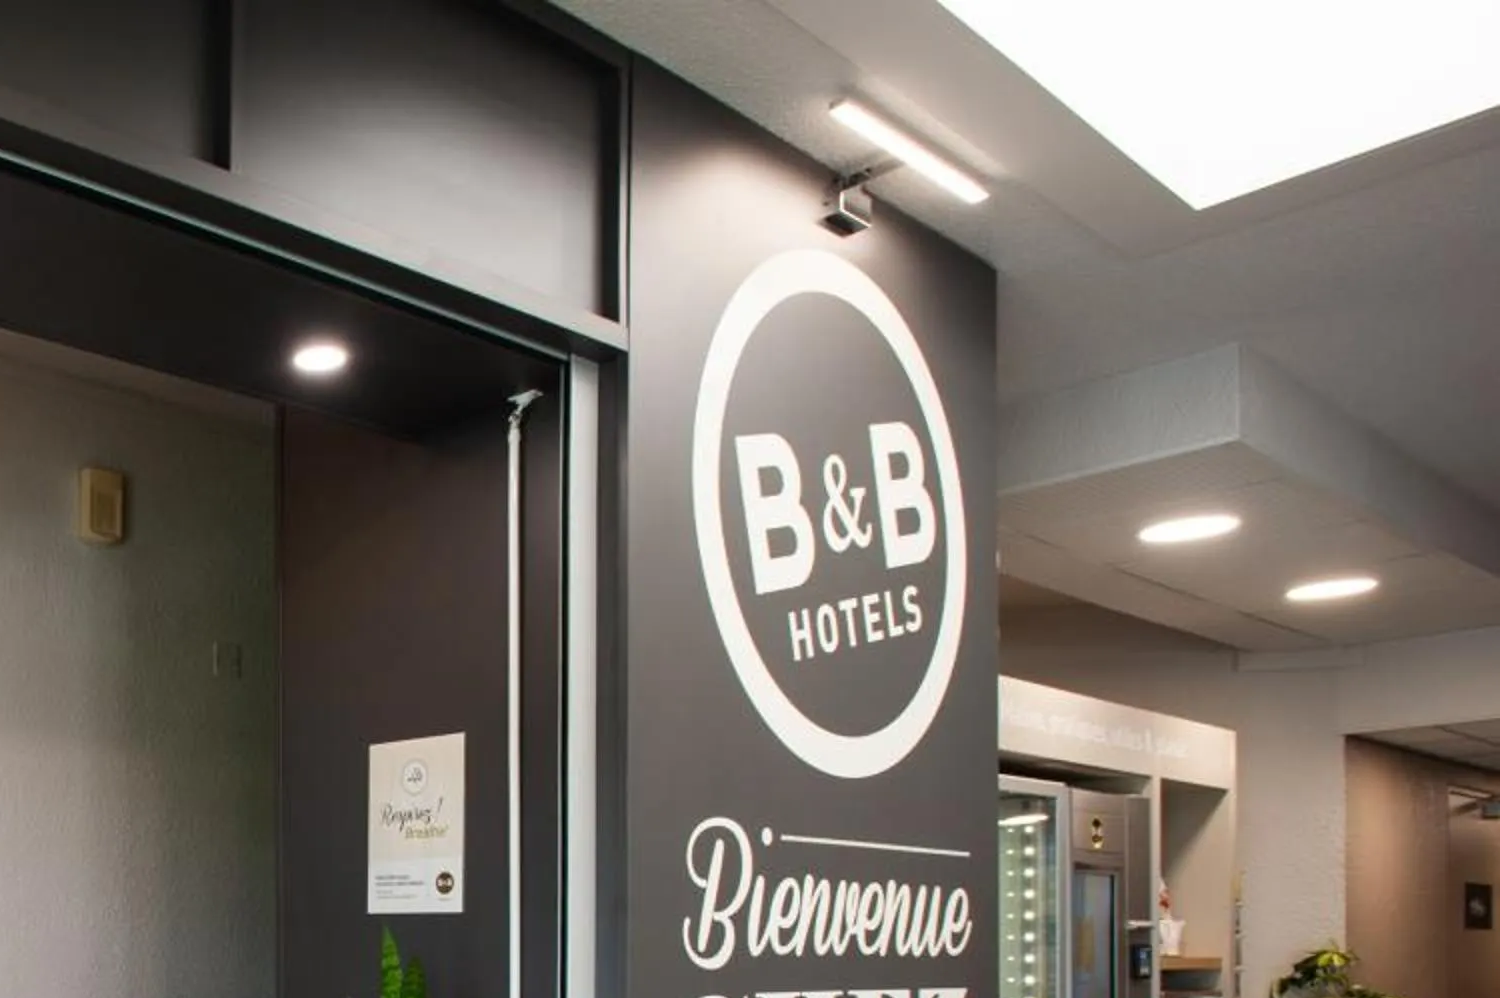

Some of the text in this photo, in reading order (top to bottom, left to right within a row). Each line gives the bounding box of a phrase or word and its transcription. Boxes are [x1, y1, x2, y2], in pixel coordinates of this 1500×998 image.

[735, 421, 936, 595] B&B
[788, 586, 923, 661] HOTELS
[683, 816, 973, 970] Bienvenue
